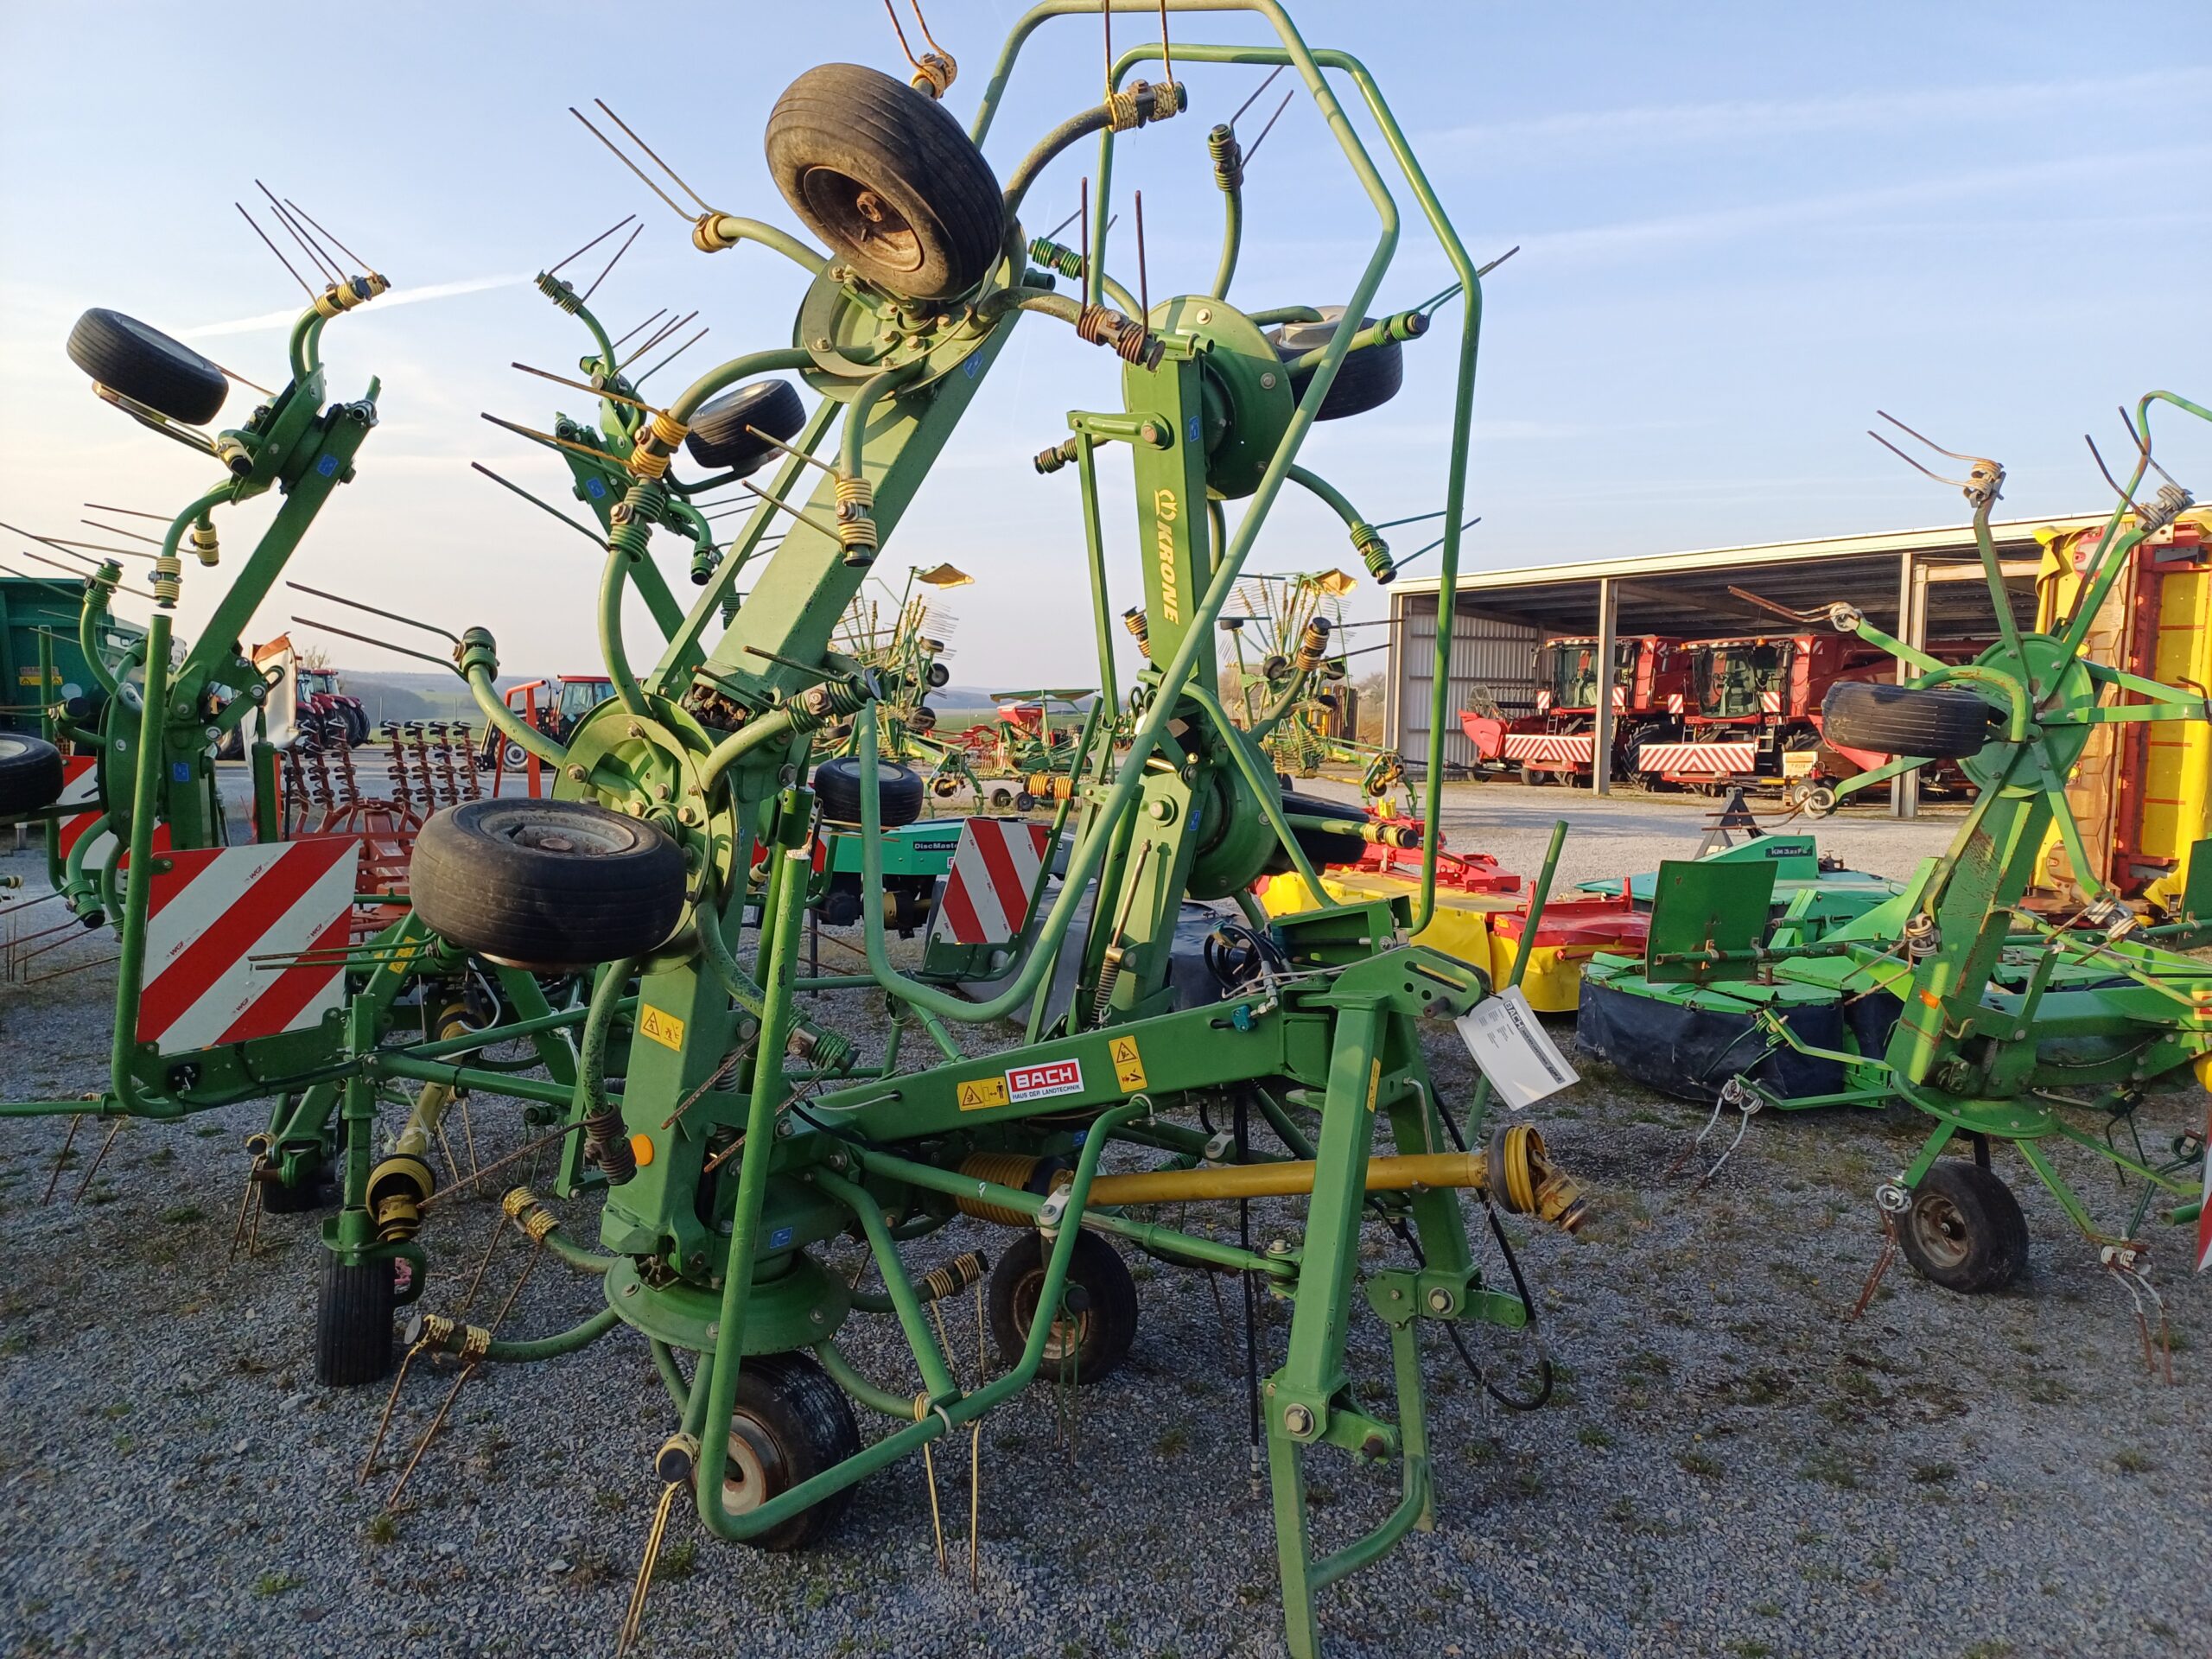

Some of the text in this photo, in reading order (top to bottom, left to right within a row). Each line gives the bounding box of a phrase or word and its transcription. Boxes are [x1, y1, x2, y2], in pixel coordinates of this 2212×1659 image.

[1156, 519, 1179, 626] KRONE
[1503, 1001, 1525, 1029] BACH
[1014, 1066, 1073, 1089] BACH
[1042, 1084, 1080, 1096] LANDTECHNIK
